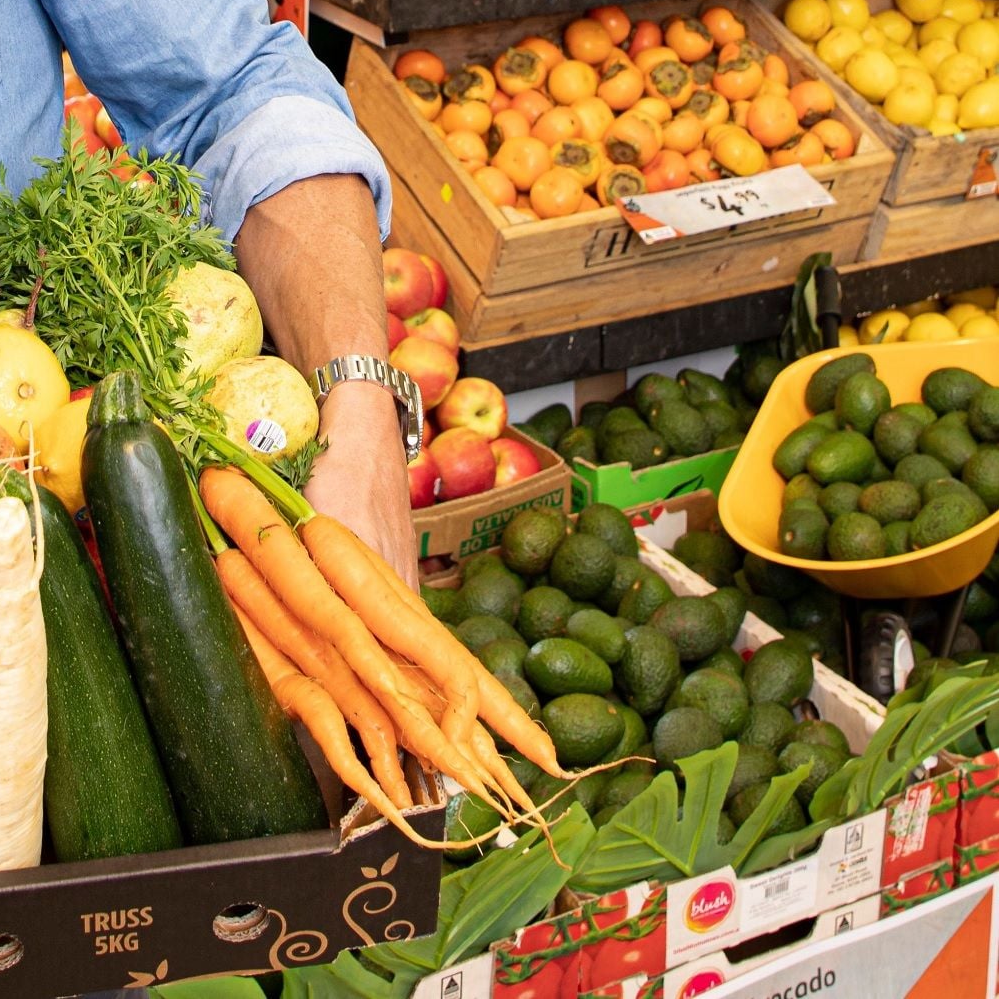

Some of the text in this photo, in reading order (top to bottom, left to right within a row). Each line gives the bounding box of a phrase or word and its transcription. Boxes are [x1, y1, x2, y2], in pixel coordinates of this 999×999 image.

[690, 890, 731, 918] blush
[80, 906, 154, 935] TRUSS
[95, 932, 139, 956] 5KG
